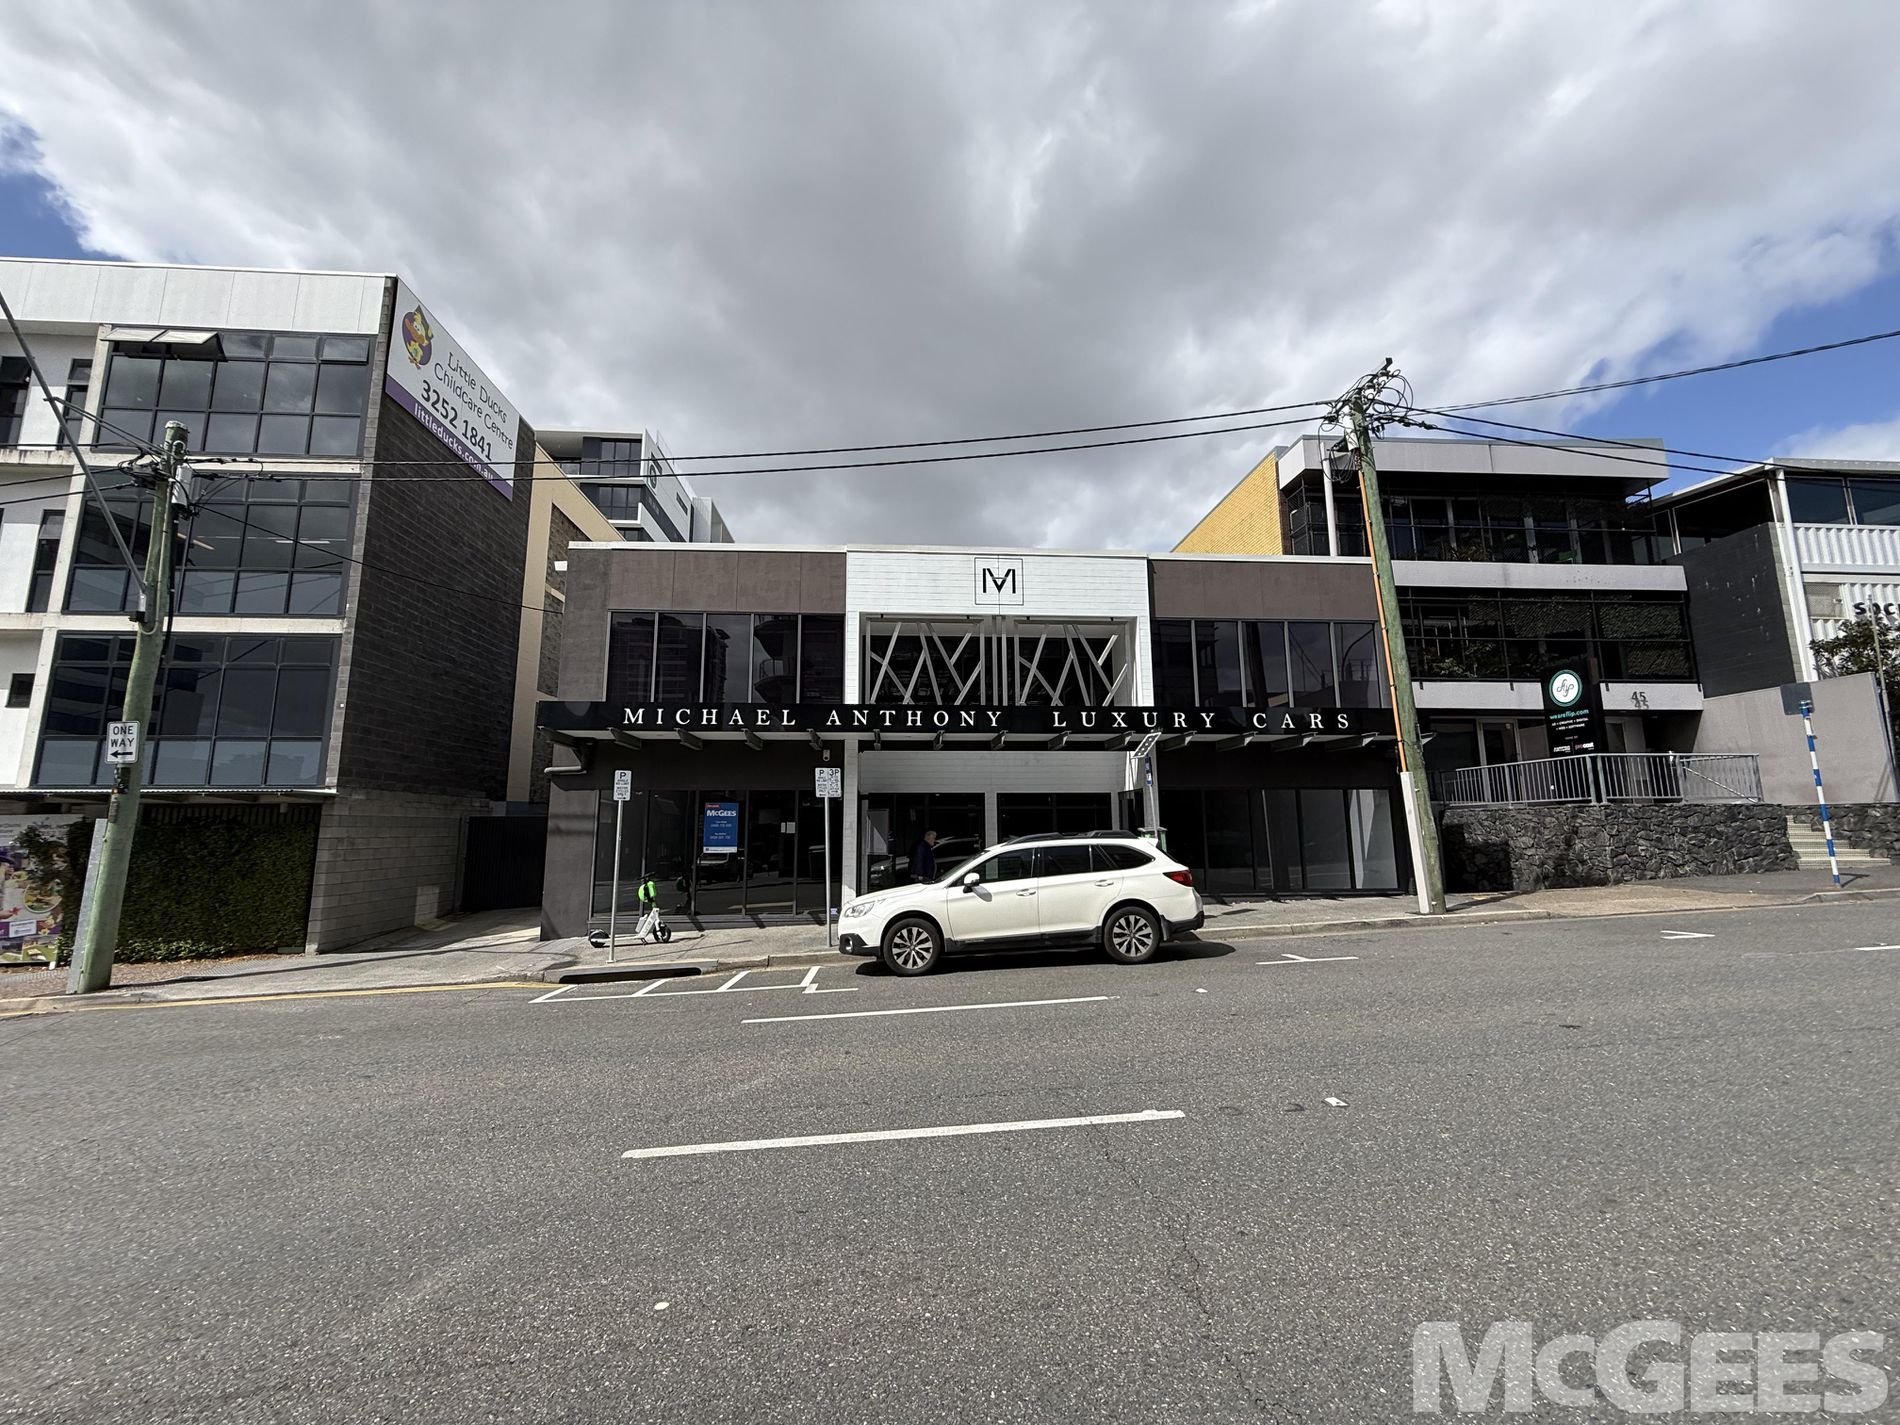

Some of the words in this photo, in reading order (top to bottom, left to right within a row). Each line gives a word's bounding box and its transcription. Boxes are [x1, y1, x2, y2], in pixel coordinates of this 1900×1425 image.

[447, 351, 477, 390] Little
[479, 385, 508, 424] Ducks
[434, 362, 483, 418] Childcare
[483, 413, 513, 449] Centre
[421, 379, 458, 429] 3252
[461, 419, 492, 461] 1841
[1853, 601, 1900, 616] SOC
[1631, 691, 1647, 702] 45
[623, 707, 796, 725] MICHAEL
[826, 709, 1002, 727] ANTHONY
[1052, 711, 1216, 728] LUXURY
[1252, 712, 1349, 729] CARS
[112, 725, 134, 735] ONE
[110, 737, 135, 747] WAY
[619, 771, 627, 780] P
[819, 769, 825, 777] P
[829, 768, 840, 777] 3P
